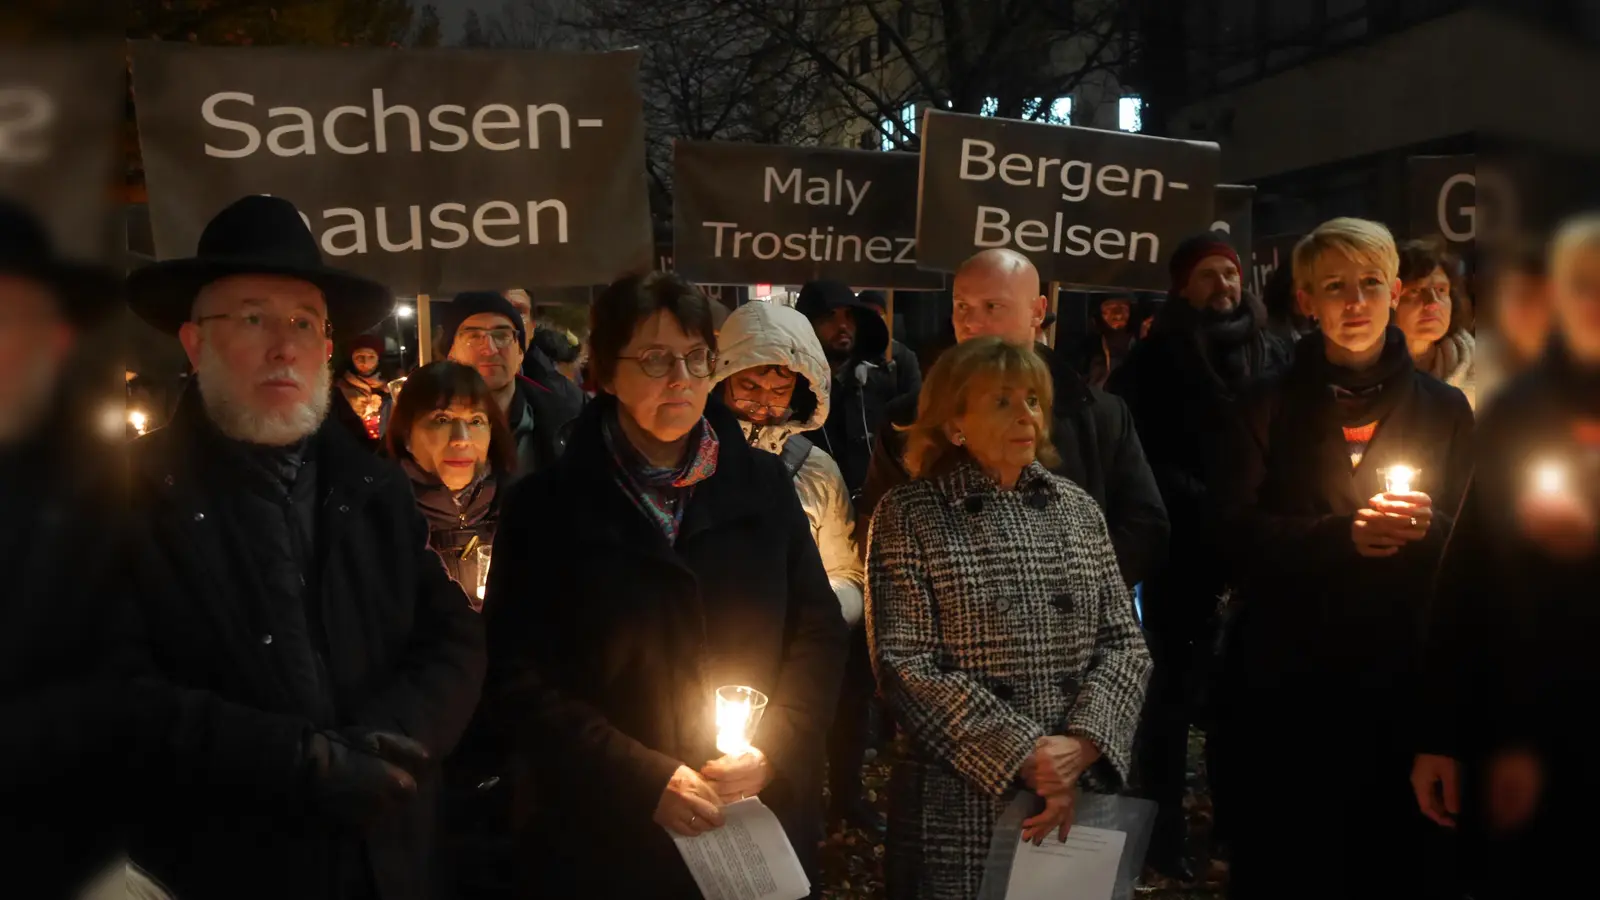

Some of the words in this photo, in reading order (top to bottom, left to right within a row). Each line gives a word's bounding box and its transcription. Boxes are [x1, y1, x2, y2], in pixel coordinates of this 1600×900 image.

[201, 88, 604, 159] Sachsen-
[764, 166, 872, 215] Maly
[959, 138, 1190, 203] Bergen-
[297, 198, 569, 256] ausen
[702, 221, 917, 265] Trostinez
[974, 205, 1160, 263] Belsen
